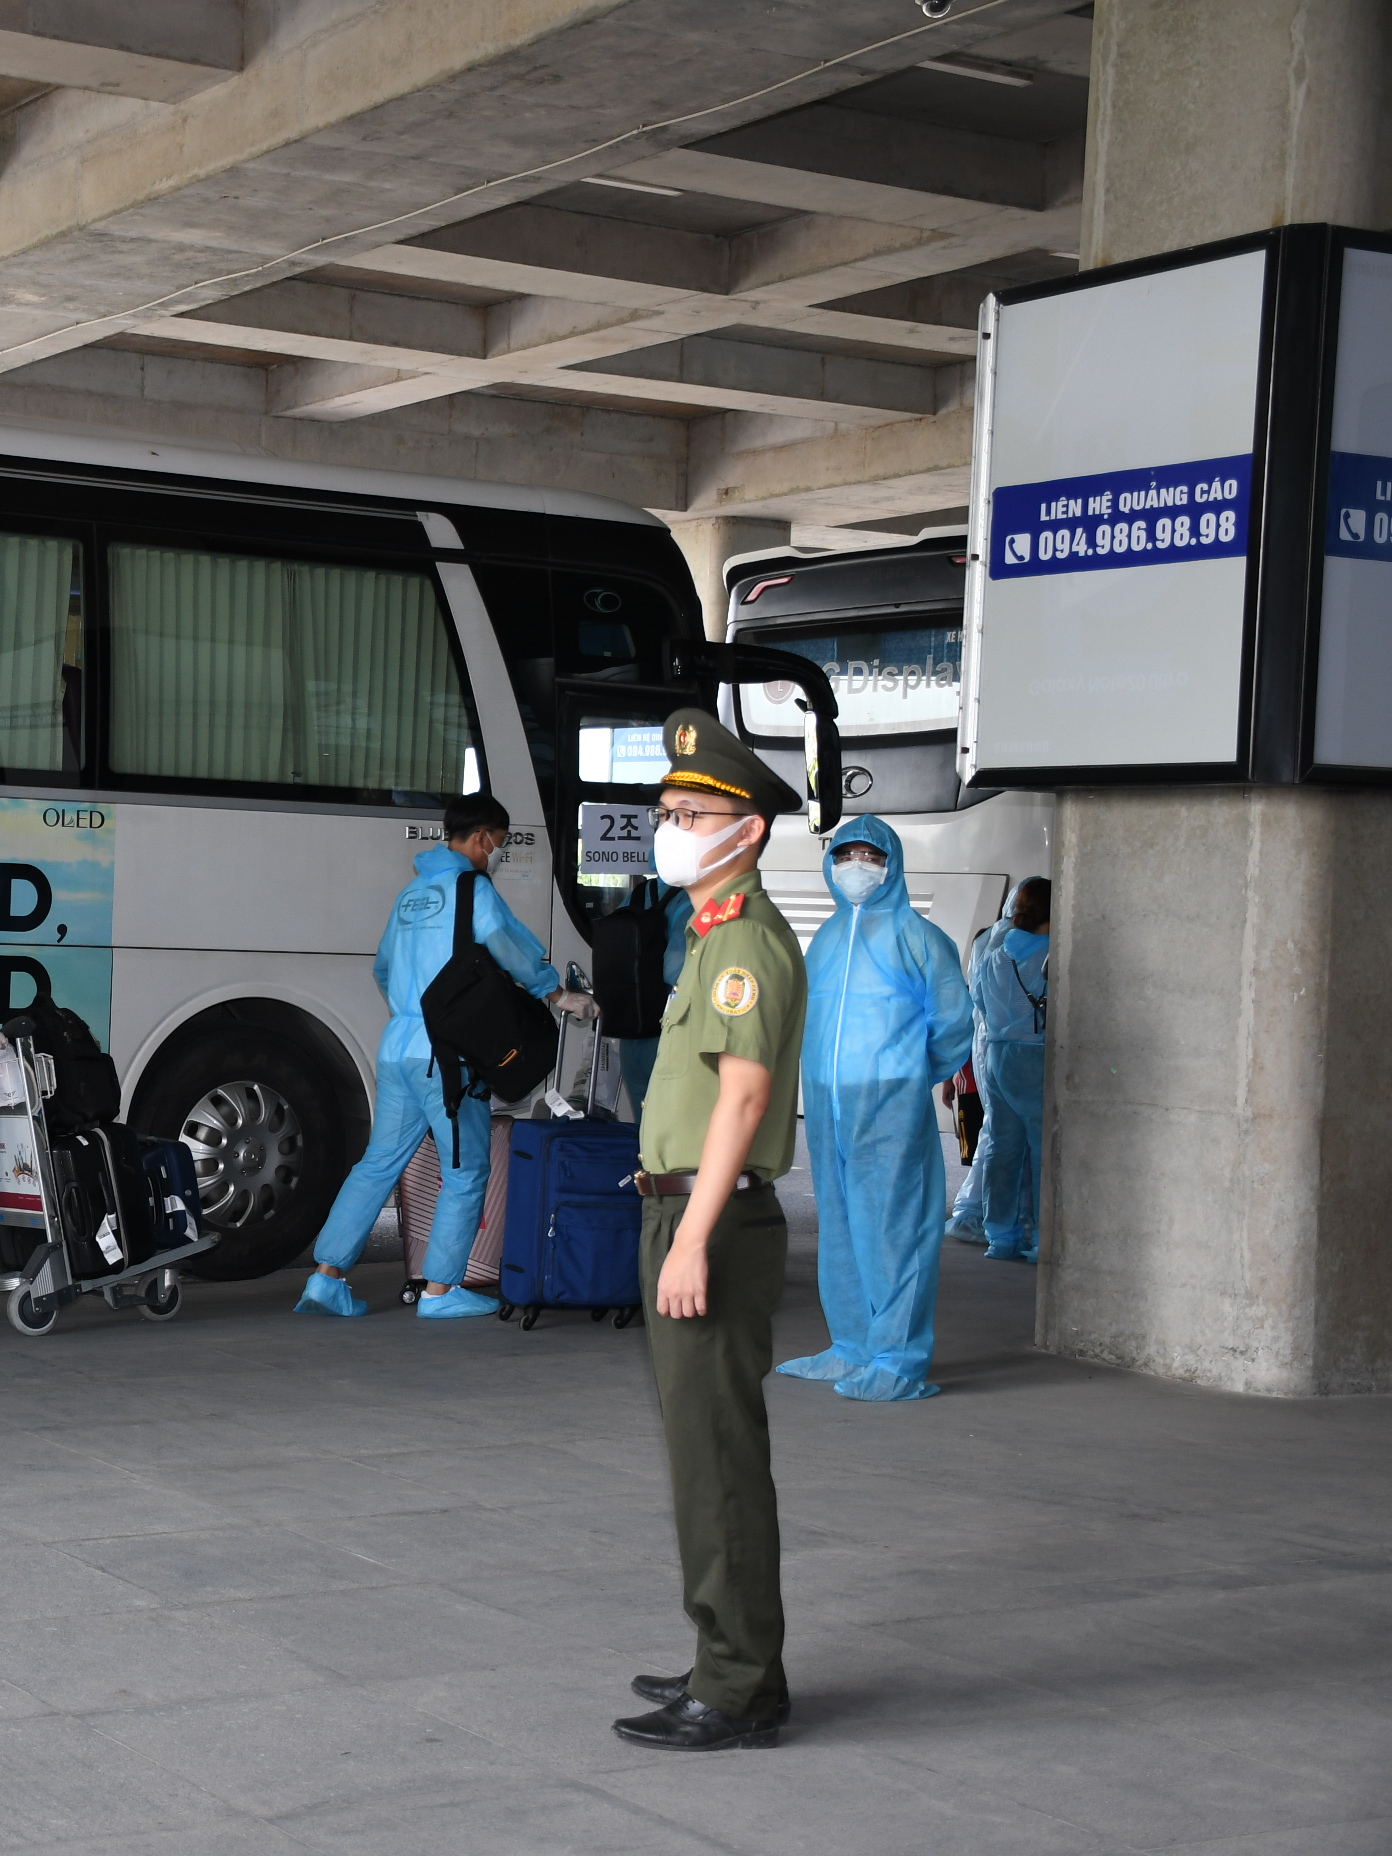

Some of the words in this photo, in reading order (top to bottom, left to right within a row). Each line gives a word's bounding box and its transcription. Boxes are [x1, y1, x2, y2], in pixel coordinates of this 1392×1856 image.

[1039, 497, 1082, 522] LIÊN
[1087, 491, 1112, 519] HỆ
[1118, 482, 1188, 514] QUẢNG
[1194, 477, 1238, 503] CÁO
[1038, 510, 1236, 562] 094.986.98.98
[1373, 512, 1392, 544] 0
[847, 654, 962, 700] Displa
[42, 807, 106, 829] OLED
[599, 814, 642, 842] 2조
[512, 851, 534, 863] Wi-Fi
[585, 850, 619, 863] SONO
